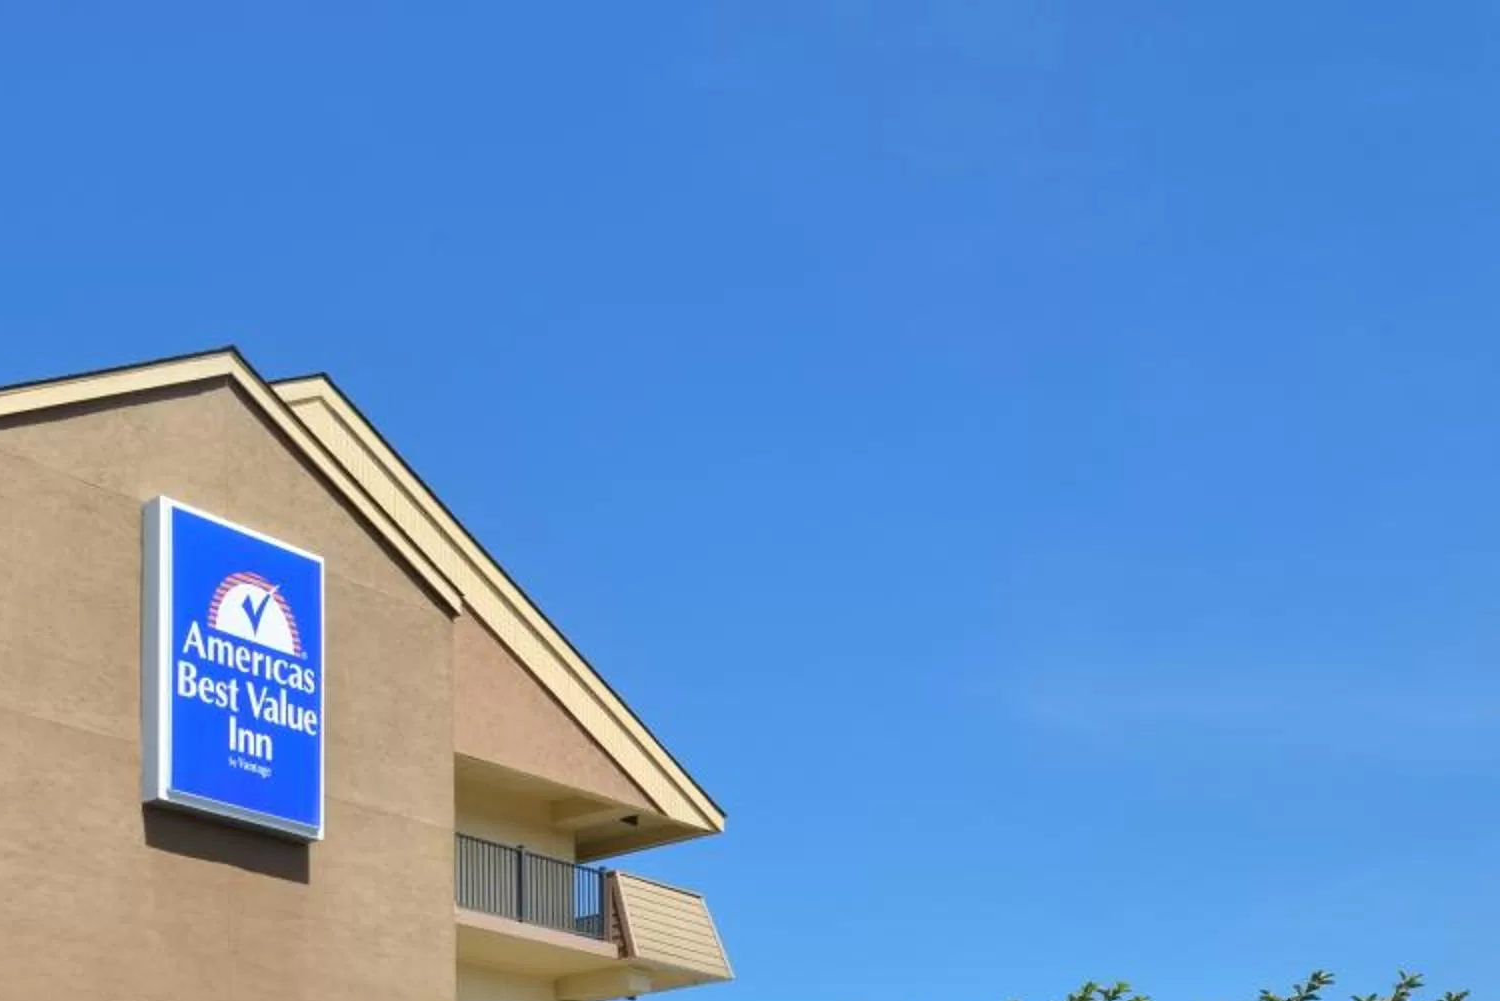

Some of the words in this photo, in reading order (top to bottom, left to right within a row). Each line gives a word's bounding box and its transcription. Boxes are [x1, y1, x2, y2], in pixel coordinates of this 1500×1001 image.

[183, 621, 315, 694] Americas
[177, 660, 239, 712] Best
[246, 681, 318, 736] Value
[229, 715, 273, 760] Inn
